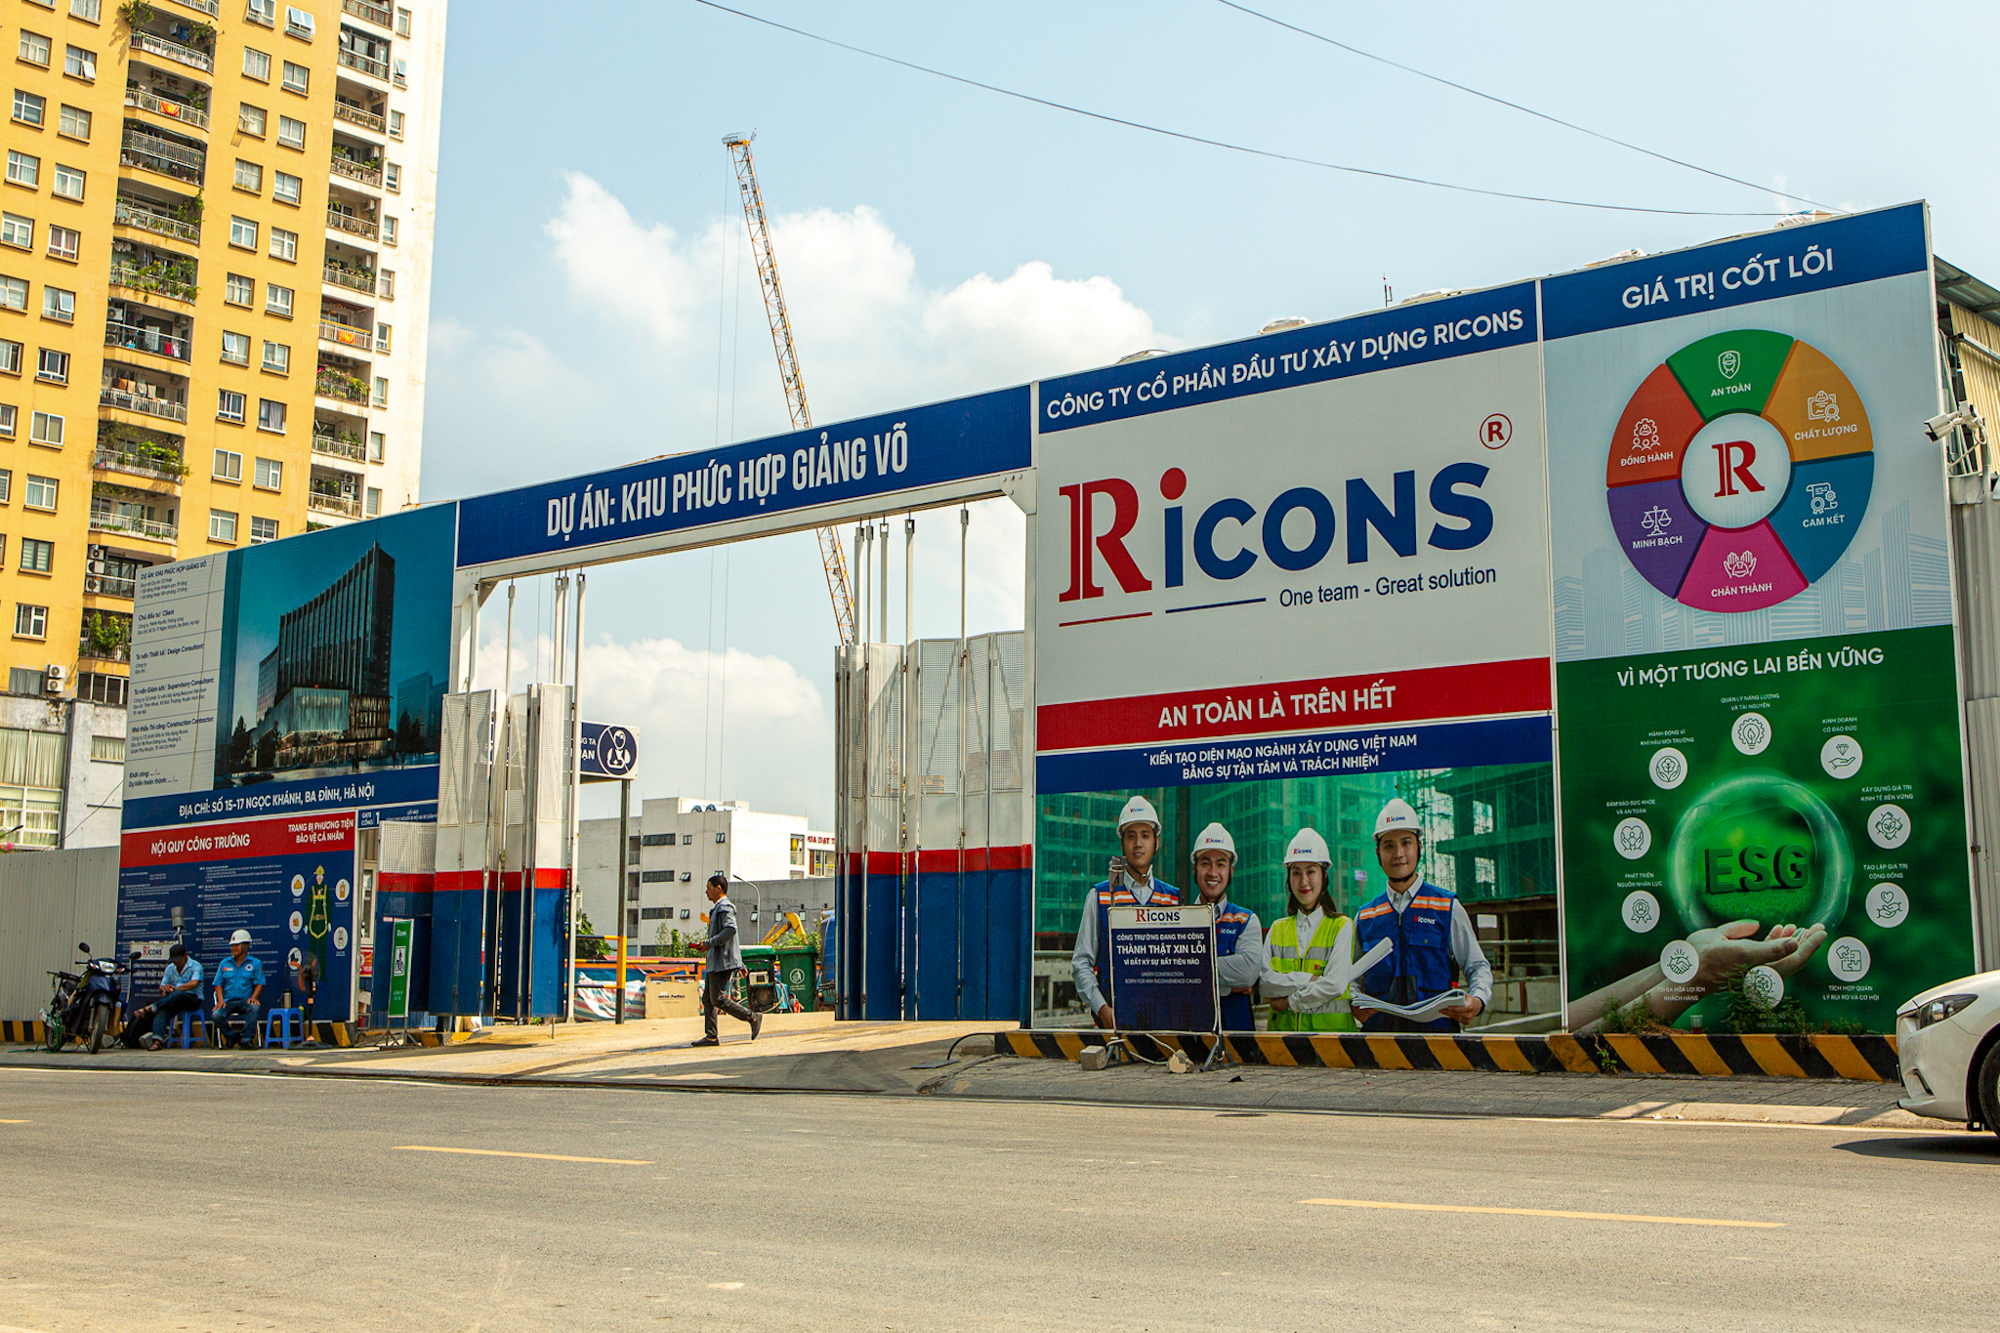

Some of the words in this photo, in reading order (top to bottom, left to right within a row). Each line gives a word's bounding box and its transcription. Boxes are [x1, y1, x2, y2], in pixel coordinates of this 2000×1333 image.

[1622, 276, 1669, 309] GIÁ
[1675, 272, 1715, 300] TRỊ
[1722, 252, 1780, 290] CỐT
[1788, 244, 1834, 278] LÕI
[1046, 390, 1105, 419] CÔNG
[1108, 387, 1133, 408] TY
[1137, 370, 1168, 402] CỔ
[1172, 363, 1226, 396] PHẦN
[1232, 352, 1275, 385] ĐẦU
[1280, 350, 1308, 376] TƯ
[1312, 340, 1356, 369] XÂY
[1362, 330, 1428, 361] DỰNG
[1434, 308, 1524, 346] RICONS
[1710, 388, 1724, 398] AN
[1726, 383, 1752, 396] TOÀN
[1794, 428, 1820, 441] CHẤT
[1822, 424, 1858, 439] LƯỢNG
[1620, 454, 1646, 467] ĐỒNG
[1648, 451, 1674, 463] HÀNH
[1711, 440, 1765, 498] R
[547, 492, 576, 541] DỰ
[579, 484, 615, 531] ÁN:
[621, 476, 666, 523] KHU
[672, 459, 732, 513] PHỨC
[738, 453, 786, 505] HỢP
[792, 432, 867, 491] GIẢNG
[874, 421, 908, 477] VÕ
[1802, 517, 1825, 528] CAM
[1826, 514, 1845, 526] KẾT
[1632, 538, 1656, 549] MINH
[1658, 536, 1683, 547] BẠCH
[1280, 588, 1314, 607] One
[1317, 584, 1359, 604] team
[1377, 573, 1425, 597] Great
[1428, 567, 1497, 592] solution
[1711, 586, 1738, 598] CHÂN
[1739, 582, 1773, 595] THÀNH
[1617, 666, 1635, 687] VÌ
[1639, 664, 1678, 688] MỘT
[1682, 658, 1749, 682] TƯƠNG
[1753, 656, 1781, 675] LAI
[1786, 649, 1822, 672] BỀN
[1827, 646, 1884, 668] VỮNG
[1158, 705, 1187, 728] AN
[1192, 696, 1252, 725] TOÀN
[1259, 691, 1285, 719] LÀ
[1290, 686, 1347, 716] TRÊN
[1353, 678, 1396, 711] HẾT
[1175, 752, 1197, 765] TẠO
[1199, 748, 1224, 764] DIỆN
[1226, 746, 1253, 762] MẠO
[1255, 743, 1296, 759] NGÀNH
[1298, 739, 1322, 755] XÂY
[1325, 739, 1359, 754] DỰNG
[1361, 734, 1387, 750] VIỆT
[1389, 734, 1418, 748] NAM
[1182, 765, 1214, 780] BẰNG
[1216, 764, 1231, 780] SỰ
[1230, 761, 1254, 778] TẬN
[1257, 760, 1281, 774] TÂM
[1282, 758, 1298, 772] VÀ
[1300, 756, 1340, 771] TRÁCH
[179, 804, 194, 818] ĐỊA
[195, 798, 210, 816] CHỈ:
[212, 796, 223, 814] SỐ
[225, 800, 244, 812] 15-17
[246, 797, 272, 812] NGỌC
[272, 792, 303, 808] KHÁNH,
[305, 792, 316, 804] BA
[318, 786, 342, 804] ĐÌNH,
[344, 786, 356, 800] HÀ
[358, 784, 375, 800] NỘI
[288, 823, 307, 833] TRANG
[308, 823, 314, 834] BỊ
[314, 820, 340, 831] PHƯƠNG
[341, 818, 354, 830] TIỆN
[376, 812, 380, 825] 1
[151, 841, 167, 856] NỘI
[168, 840, 185, 853] QUY
[186, 836, 213, 852] CÔNG
[214, 833, 250, 850] TRƯỜNG
[296, 832, 308, 844] BẢO
[309, 833, 317, 845] VỆ
[318, 832, 326, 842] CÁ
[327, 831, 345, 841] NHÂN
[1704, 844, 1809, 895] ESG
[1116, 942, 1147, 955] THÀNH
[1148, 942, 1172, 956] THẬT
[1174, 945, 1189, 954] XIN
[1190, 940, 1206, 954] LỖI
